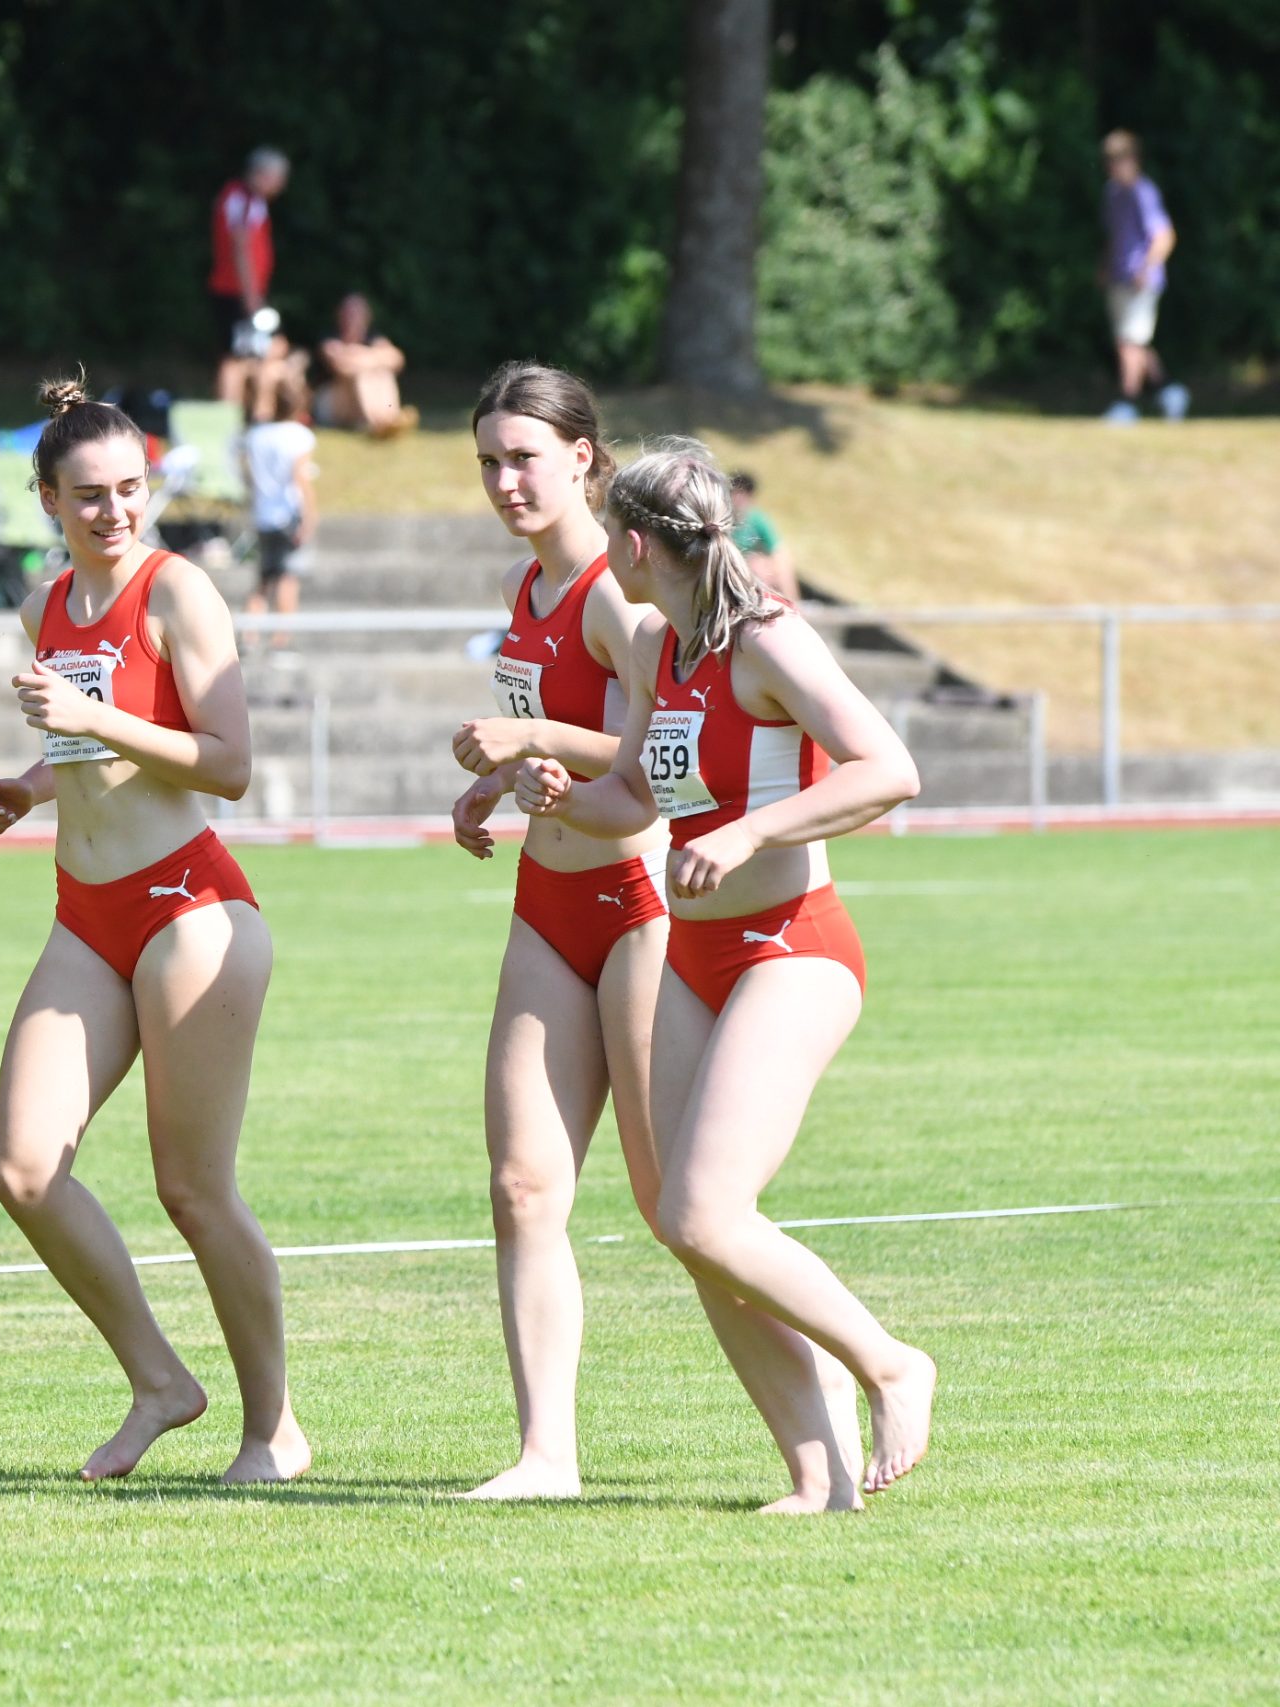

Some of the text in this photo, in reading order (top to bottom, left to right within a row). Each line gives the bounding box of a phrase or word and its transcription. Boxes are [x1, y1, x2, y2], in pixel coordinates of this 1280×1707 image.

[63, 671, 101, 683] OTON
[508, 692, 535, 719] 13
[649, 744, 690, 781] 259
